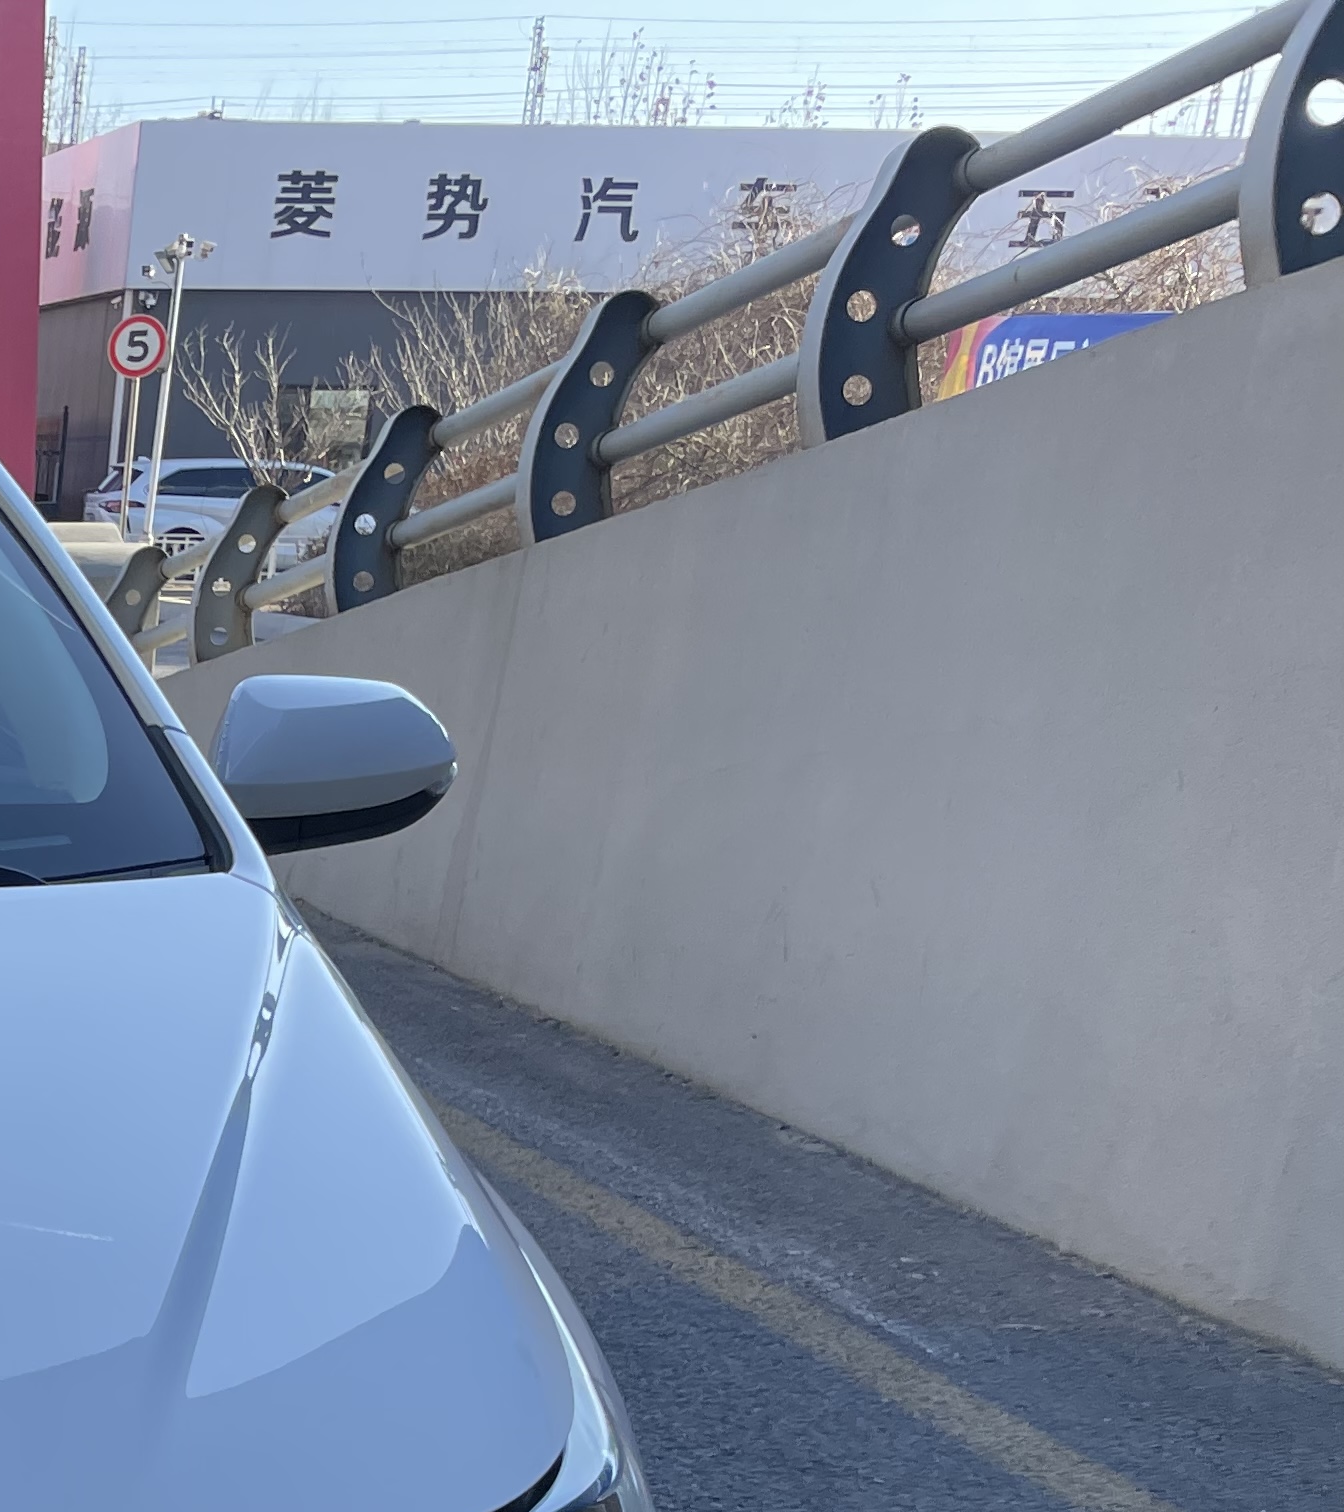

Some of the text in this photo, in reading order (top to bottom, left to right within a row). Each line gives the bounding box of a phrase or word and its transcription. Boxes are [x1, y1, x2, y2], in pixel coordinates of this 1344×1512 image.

[269, 169, 798, 242] 菱势汽车
[125, 329, 149, 363] 5
